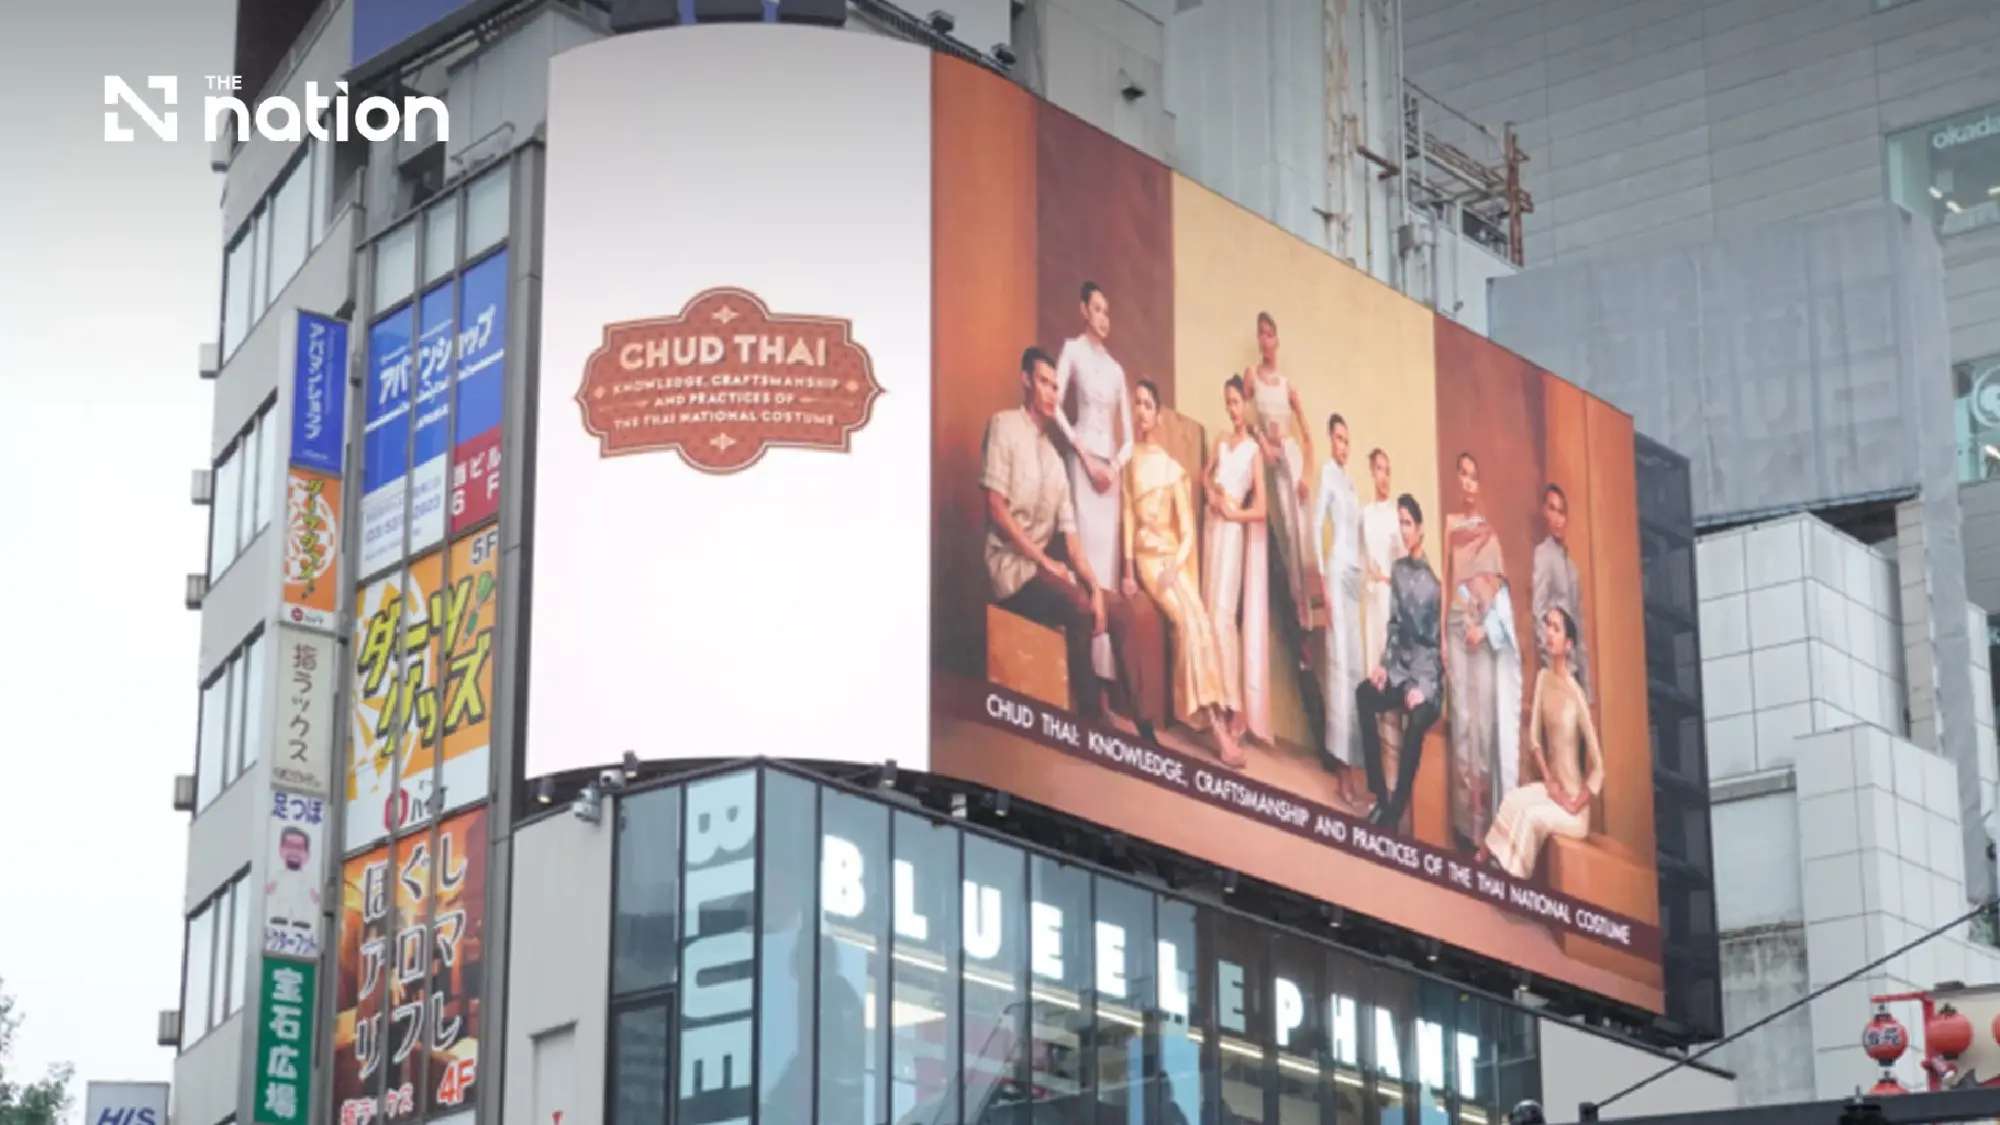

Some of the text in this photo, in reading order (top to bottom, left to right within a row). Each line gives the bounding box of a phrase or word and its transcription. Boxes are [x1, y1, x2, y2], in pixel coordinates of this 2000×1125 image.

[618, 333, 827, 371] CHUD THAI
[612, 374, 841, 395] KNOWLEDGE, CRAFTSMANSHIP
[653, 391, 796, 407] AND PRACTICES OF
[613, 410, 835, 431] THE THAI NATIONAL COSTUME
[471, 530, 499, 565] 5F
[986, 693, 1631, 946] CHUD THAI: KNOWLEDGE, CRAFTSMANSHIP AND PRACTICES OF THE THAI NATIONAL COSTUME
[363, 832, 468, 925] ほぐし
[360, 908, 466, 1001] アロマ
[355, 991, 460, 1082] リフレ
[437, 1058, 475, 1104] 4F
